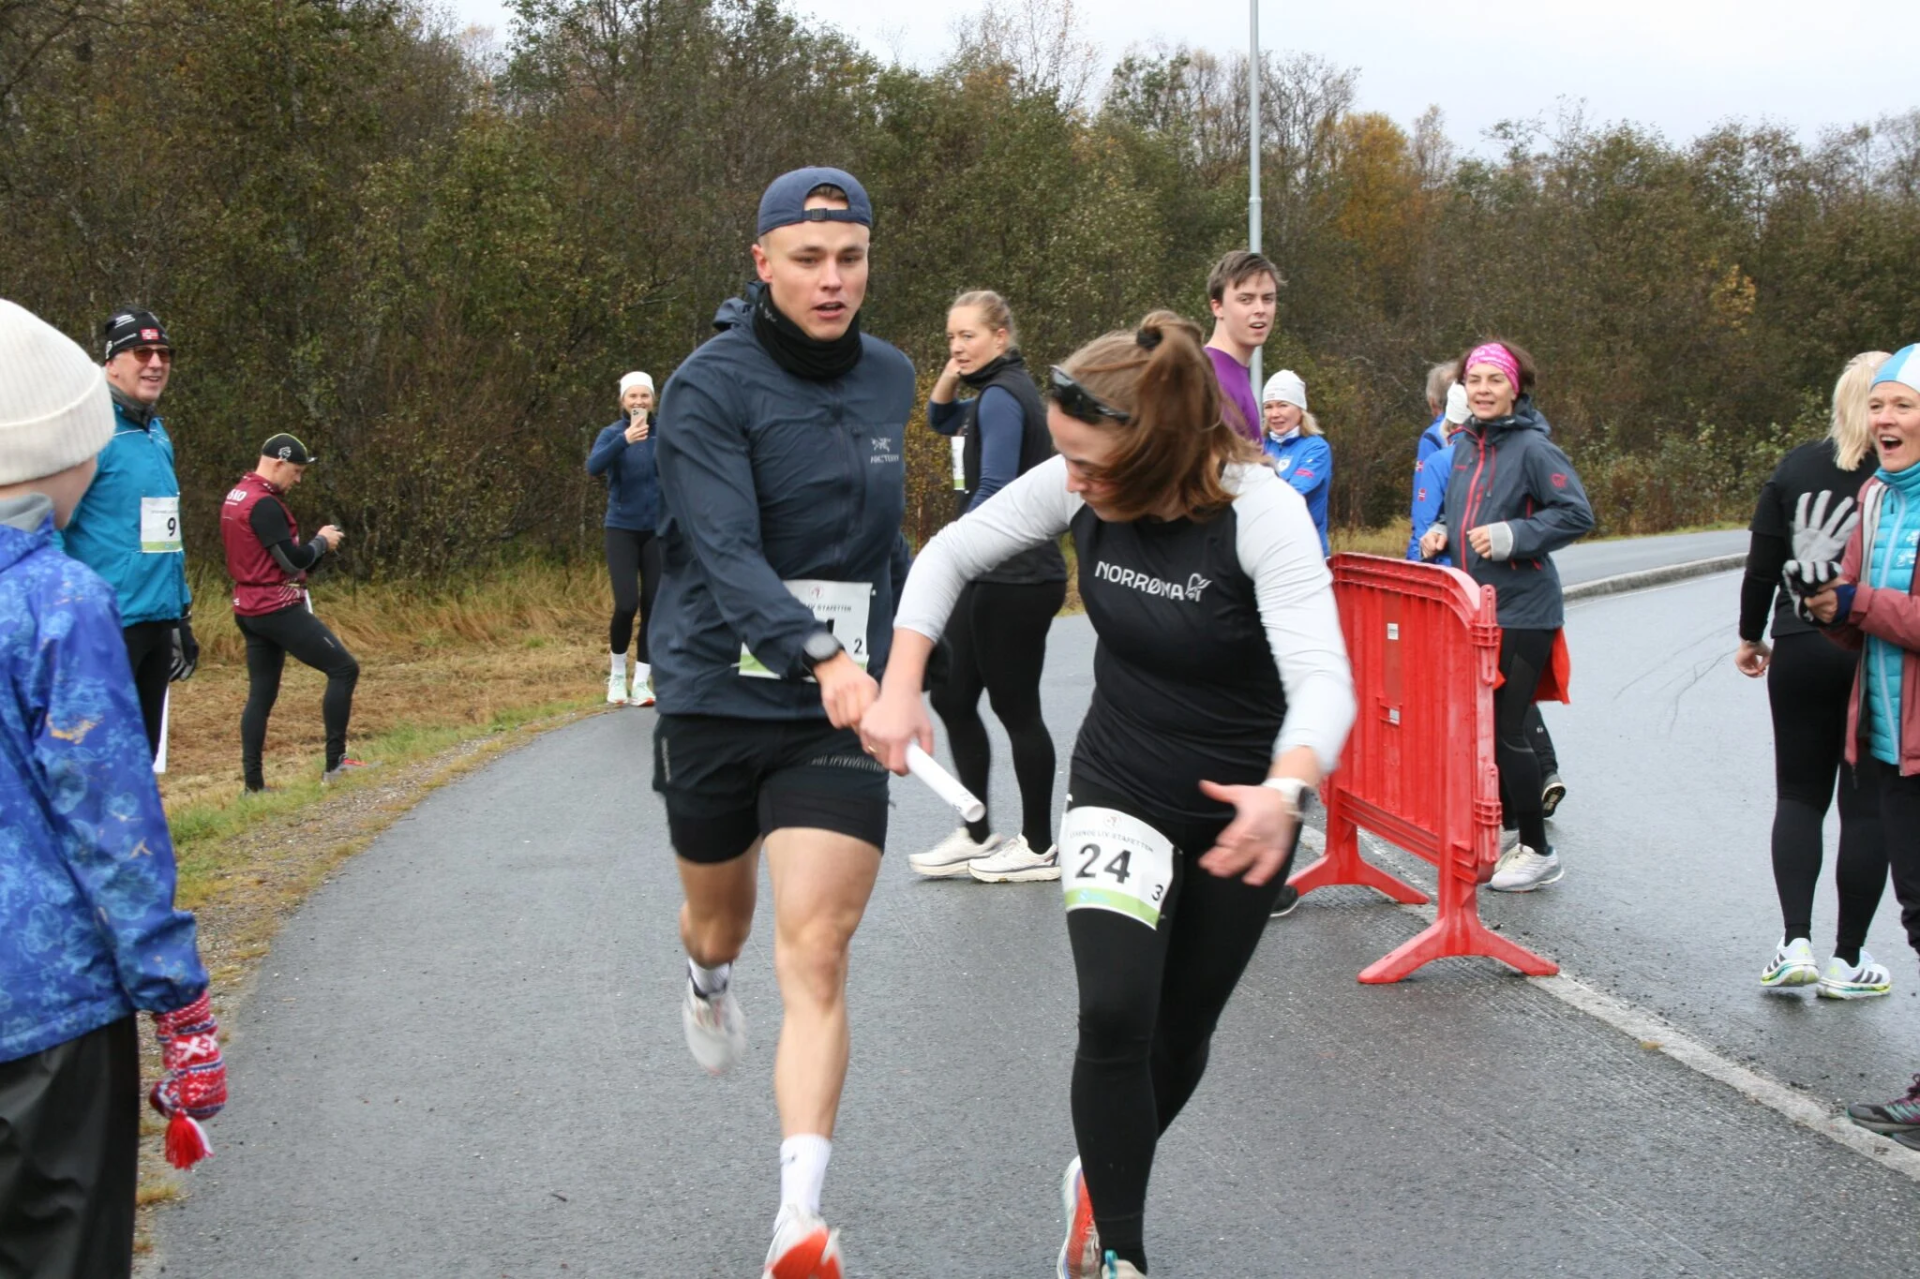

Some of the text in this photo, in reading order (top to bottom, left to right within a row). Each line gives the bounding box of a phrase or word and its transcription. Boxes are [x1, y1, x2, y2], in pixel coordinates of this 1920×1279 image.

[167, 517, 177, 537] 9
[1095, 561, 1184, 600] NORRØNA
[853, 638, 863, 655] 2
[1075, 843, 1132, 885] 24
[1151, 884, 1164, 902] 3
